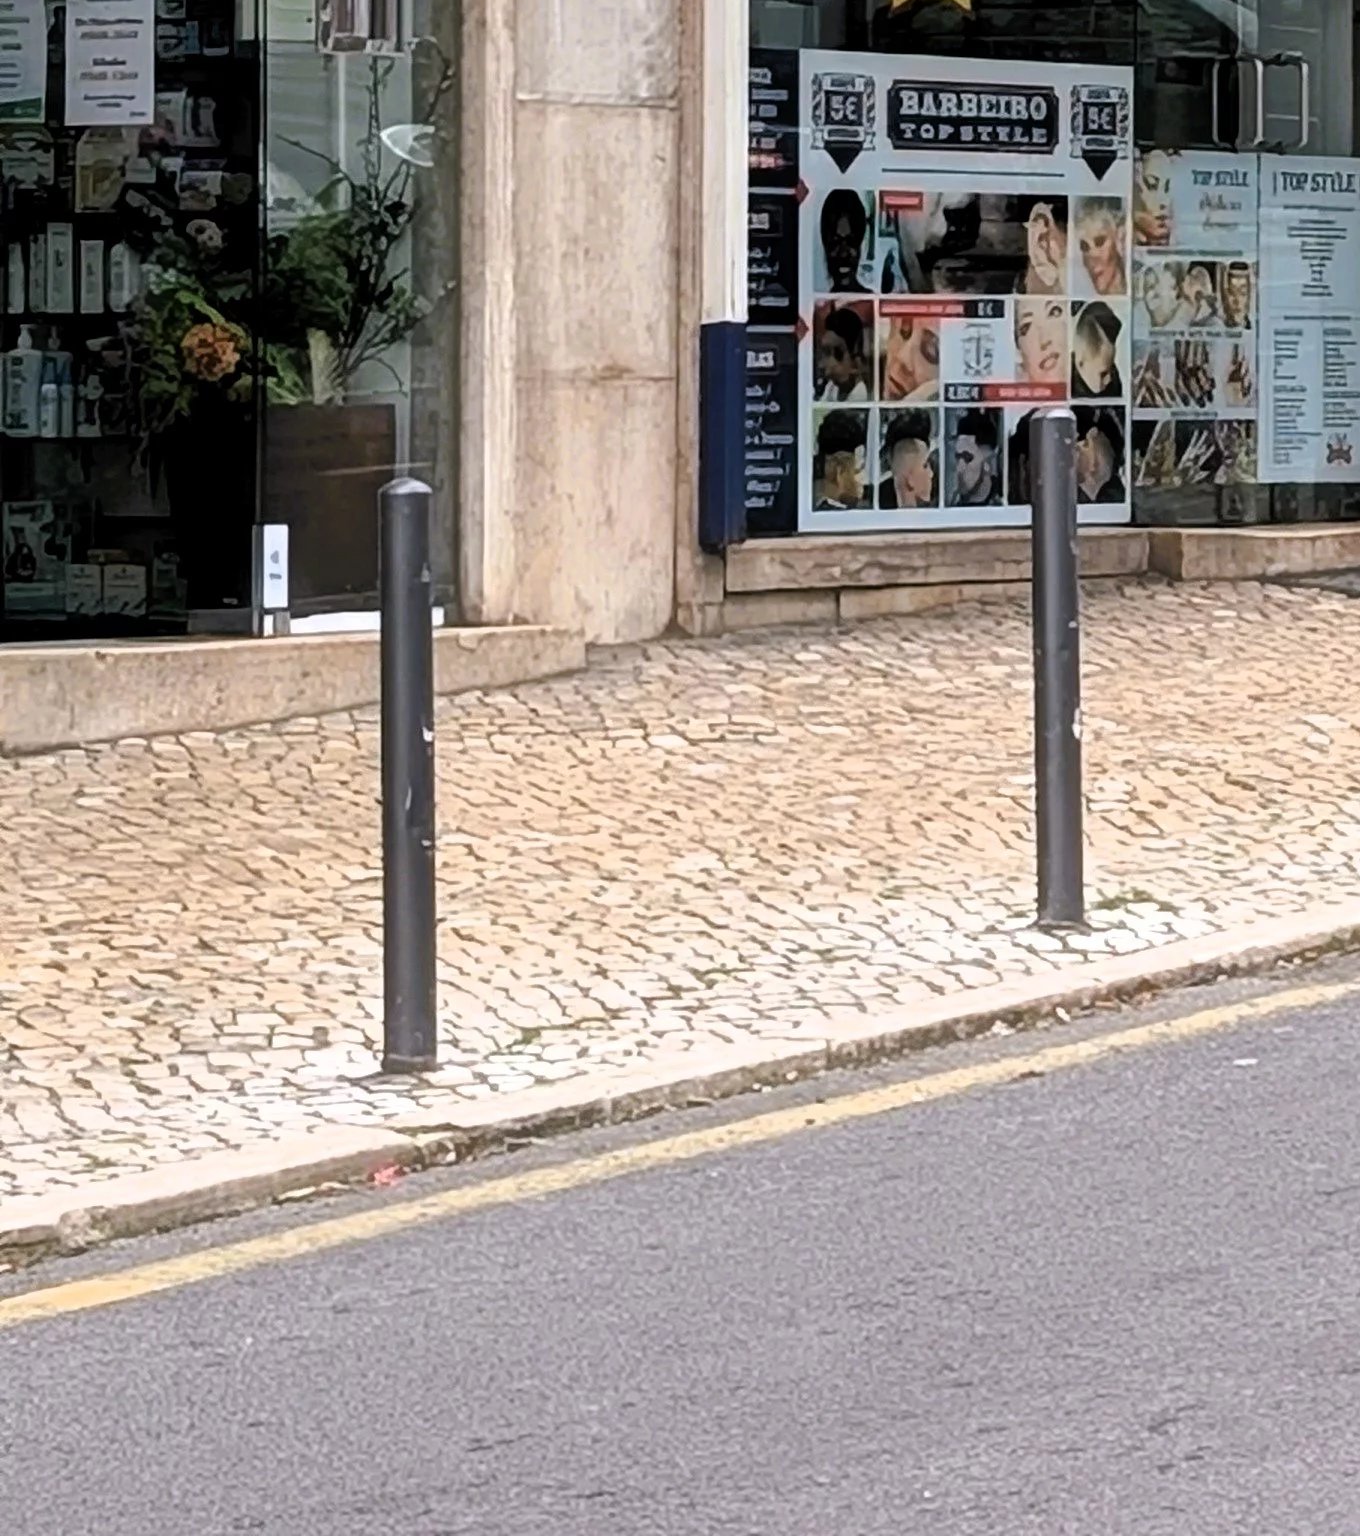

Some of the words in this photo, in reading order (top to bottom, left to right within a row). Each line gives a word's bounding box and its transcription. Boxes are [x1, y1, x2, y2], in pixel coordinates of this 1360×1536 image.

[899, 89, 1047, 122] BARBEIRO
[899, 122, 955, 142] TOP
[959, 124, 1048, 145] STYLE
[1281, 171, 1308, 192] TOP
[1310, 172, 1357, 194] STYLE
